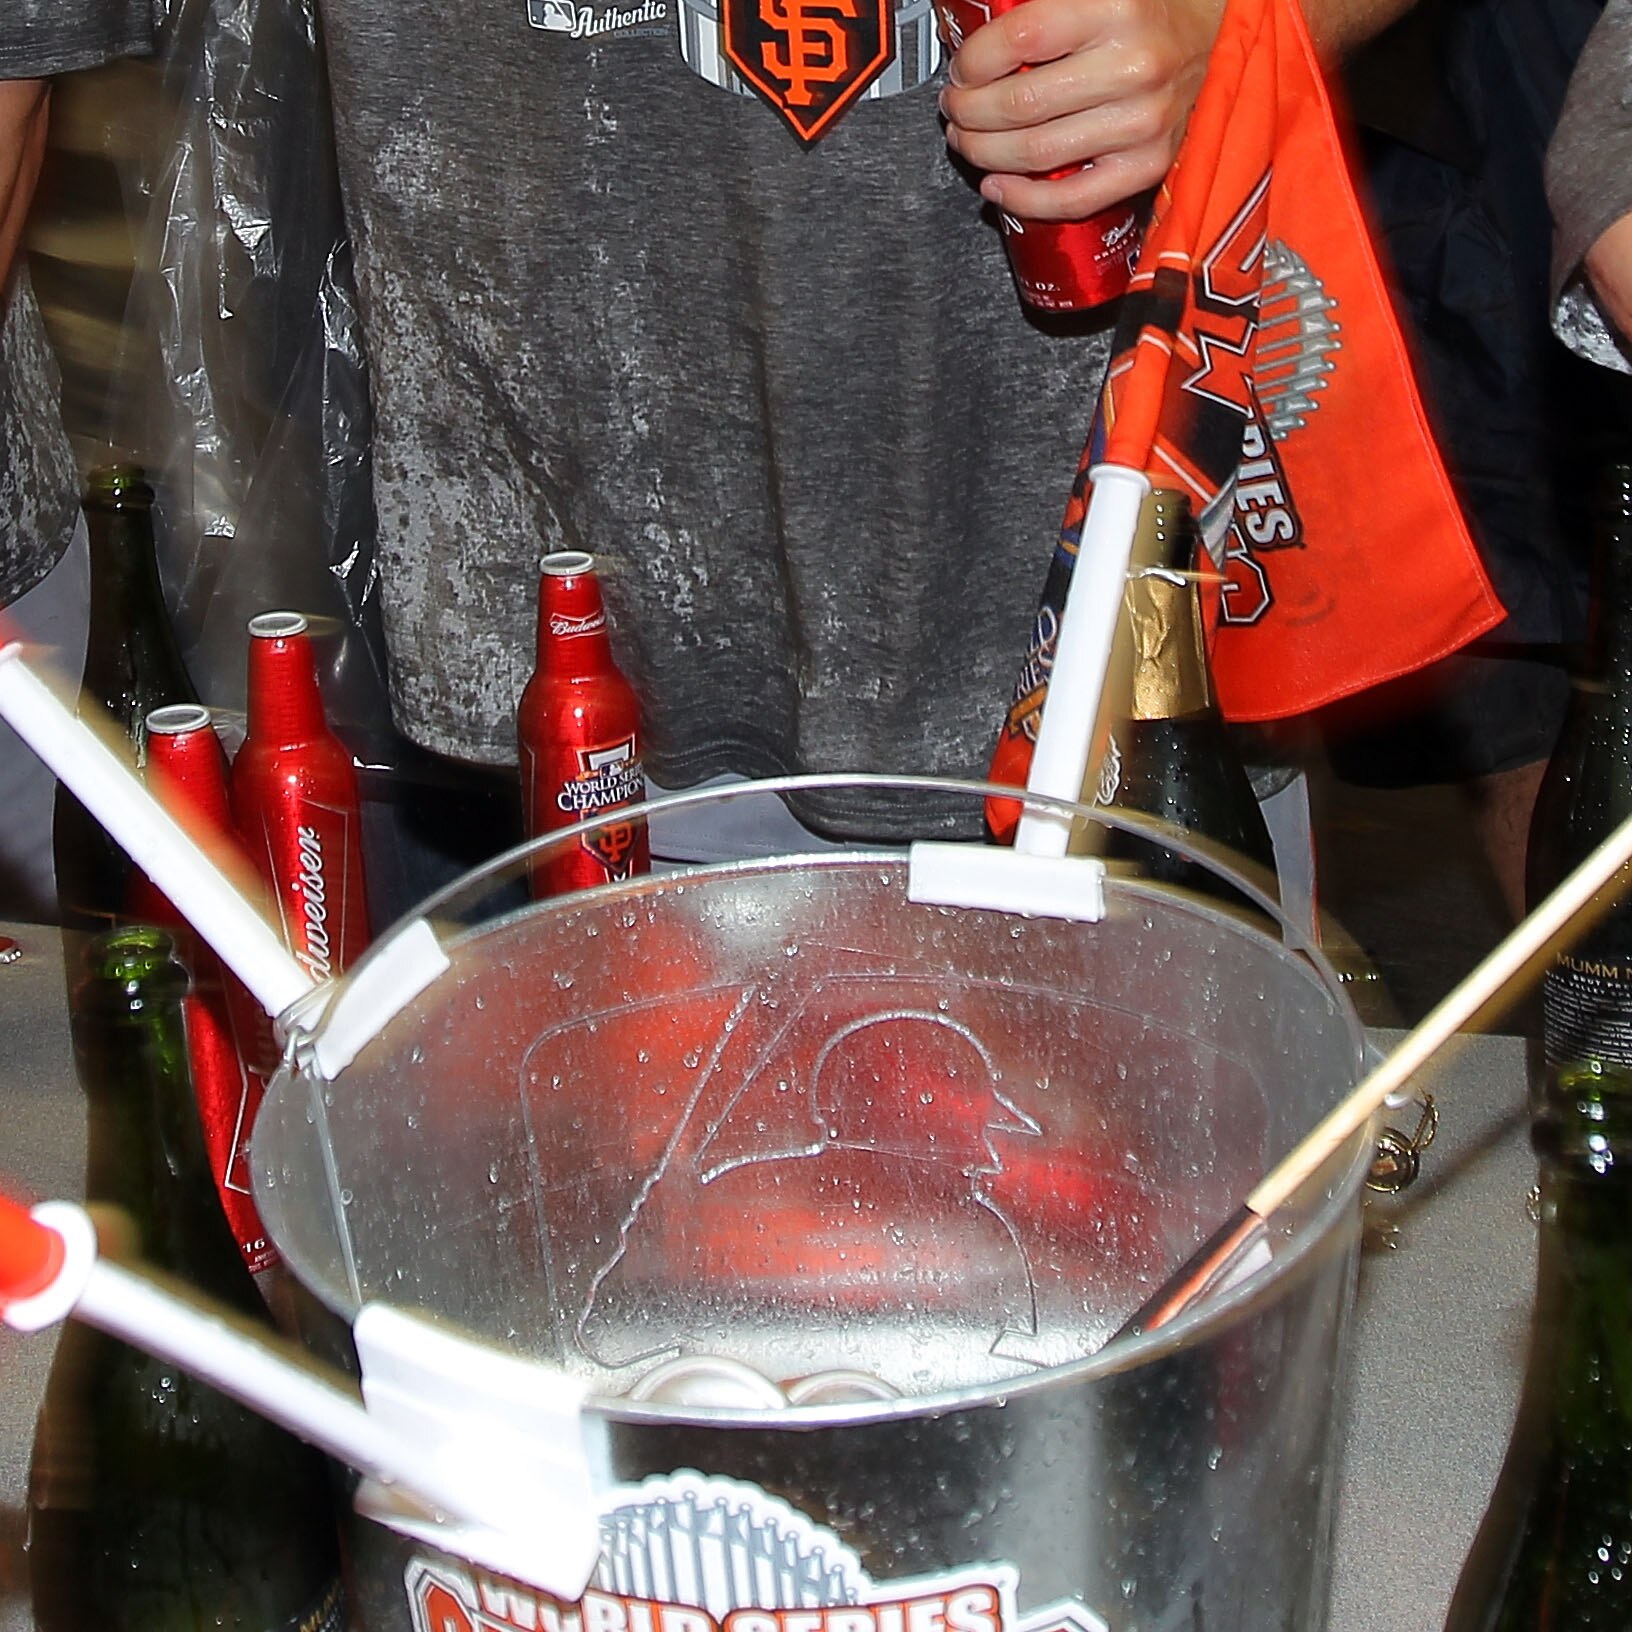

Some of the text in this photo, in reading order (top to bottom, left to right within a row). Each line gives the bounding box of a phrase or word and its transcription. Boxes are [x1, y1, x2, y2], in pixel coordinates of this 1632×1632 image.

[575, 0, 667, 39] Authentic
[558, 777, 643, 812] CHAMPION
[565, 773, 618, 796] WORLD
[292, 826, 332, 987] dweiser
[1556, 952, 1618, 979] MUMM
[1569, 981, 1605, 995] VALLEY
[1573, 974, 1601, 987] BRUT
